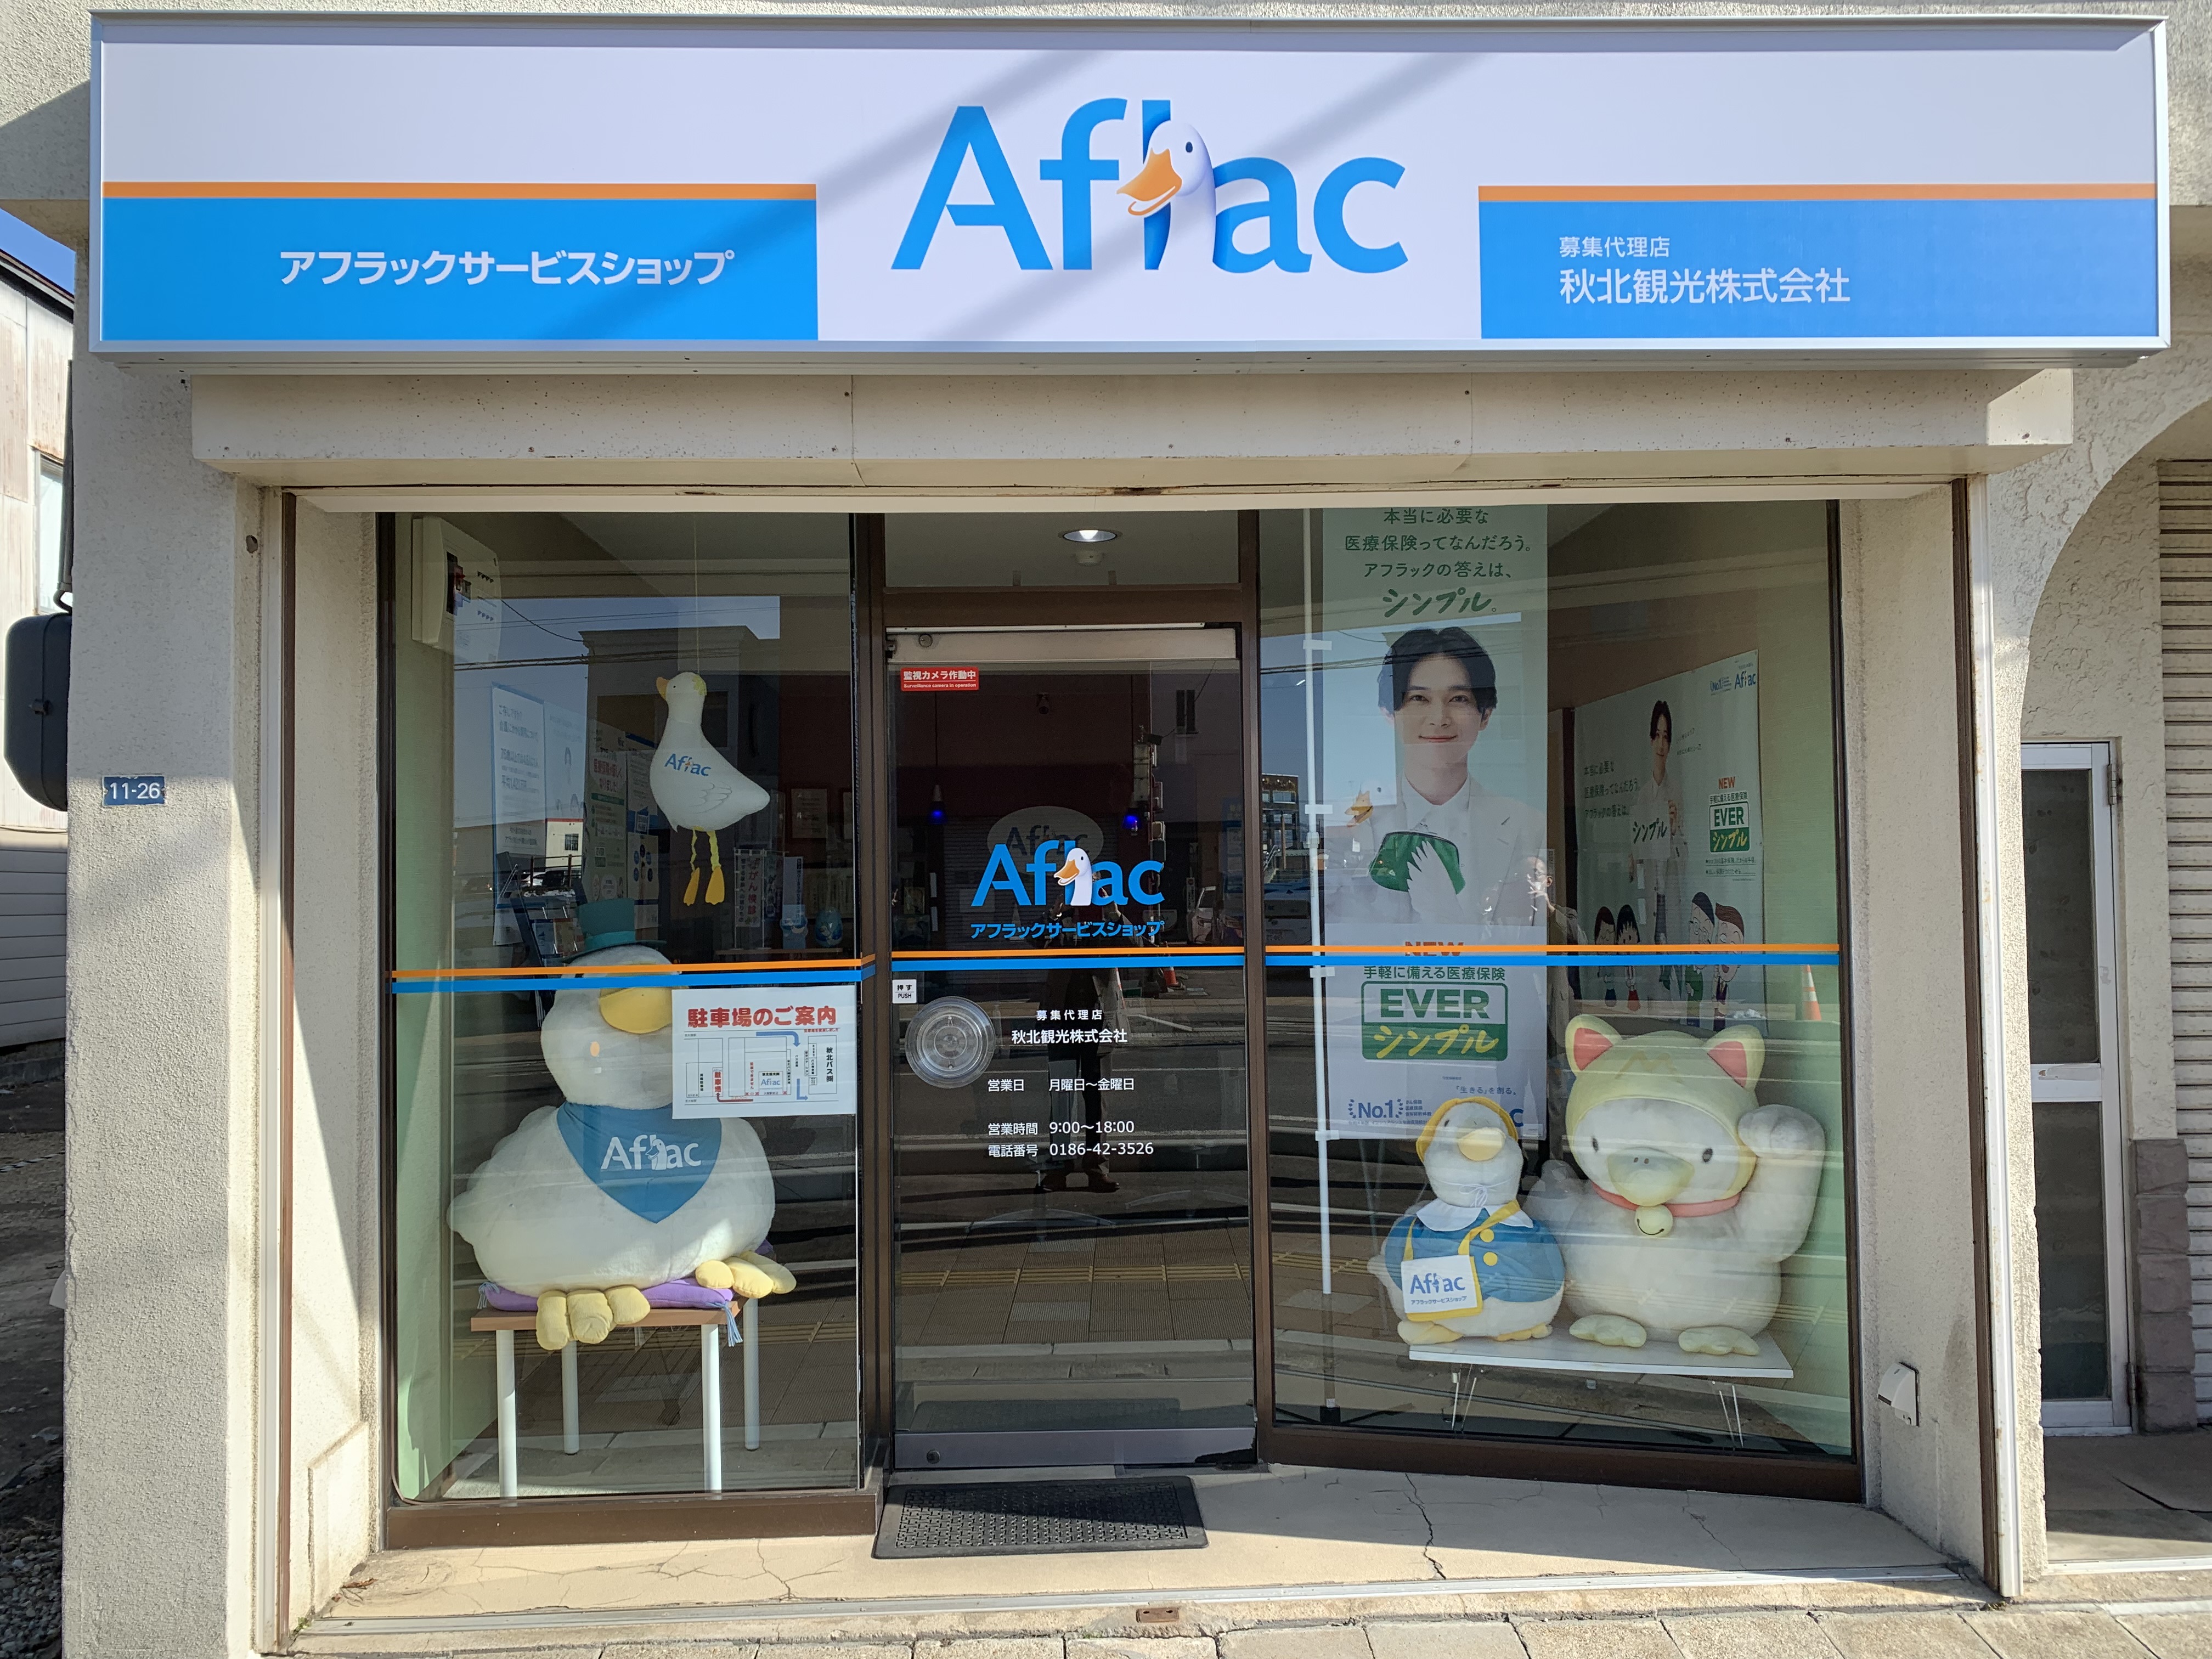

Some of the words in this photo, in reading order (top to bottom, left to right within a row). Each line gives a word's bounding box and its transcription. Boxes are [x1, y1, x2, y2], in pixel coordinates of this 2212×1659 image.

[891, 97, 1408, 273] Aflac
[1559, 236, 1671, 258] 募集代理店
[280, 249, 735, 286] アフラックサービスショップ
[1559, 267, 1851, 305] 秋北観光株式会社
[1383, 508, 1489, 524] 本当に必要な
[1344, 535, 1532, 552] 医療保険ってなんだろう。
[1364, 561, 1513, 579] アフラックの答えは、
[1381, 588, 1497, 618] シンプル。
[903, 670, 976, 680] 監視カメラ作動中
[664, 752, 712, 777] Aflac
[110, 782, 161, 800] 11-26
[1718, 776, 1736, 789] NEW
[1714, 806, 1745, 827] EVER
[971, 840, 1166, 907] Aflac
[971, 920, 1166, 940] アフラックサービスショップ
[1363, 966, 1506, 981] 手軽に備える医療保険
[1380, 988, 1490, 1019] EVER
[687, 1005, 837, 1028] 駐車場のご案内
[1036, 1009, 1103, 1022] 募集代理店
[1011, 1028, 1128, 1045] 秋北観光株式会社
[1373, 1024, 1499, 1059] シンプル
[988, 1079, 1025, 1092] 営業日
[1048, 1077, 1135, 1092] 月曜日〜金曜日
[1358, 1099, 1393, 1118] No.1
[988, 1122, 1039, 1136] 営業時間
[1048, 1120, 1135, 1135] 9:00〜18:00
[600, 1134, 702, 1171] Aflac
[988, 1144, 1039, 1158] 電話番号
[1049, 1142, 1154, 1156] 0186-42-3526
[1410, 1273, 1466, 1295] Aflac
[1410, 1295, 1467, 1305] アフラックサービスショップ
